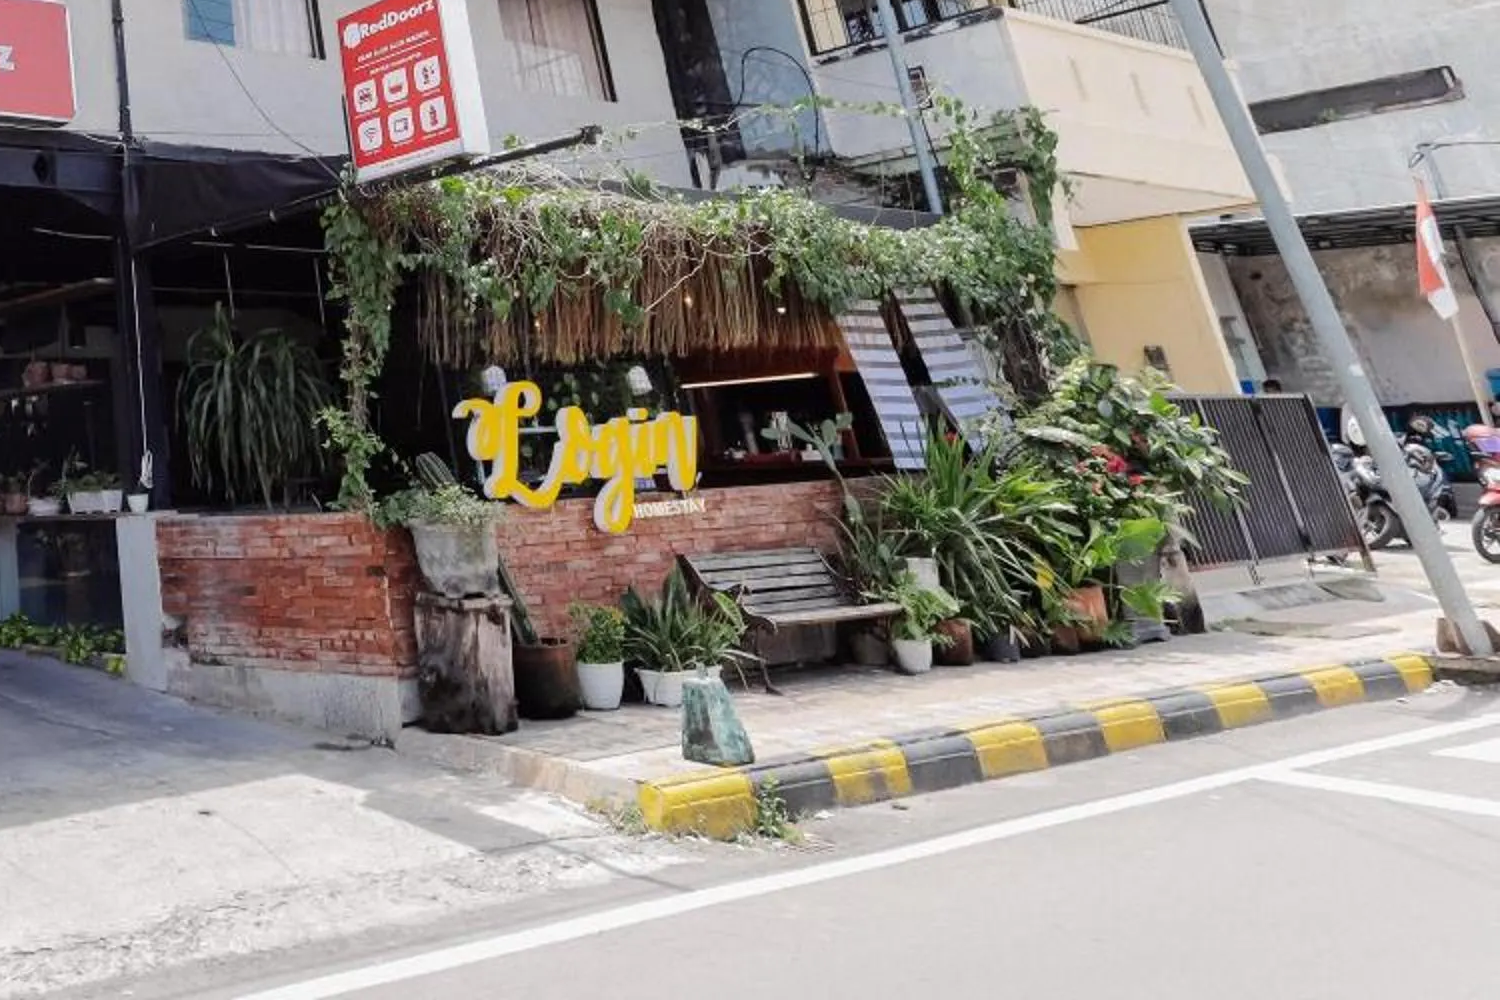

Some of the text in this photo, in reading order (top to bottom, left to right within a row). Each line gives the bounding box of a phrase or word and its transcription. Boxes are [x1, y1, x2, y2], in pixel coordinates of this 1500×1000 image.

[360, 0, 435, 39] RedDoorz
[452, 380, 697, 535] Login
[633, 498, 706, 519] HOMESTAY
